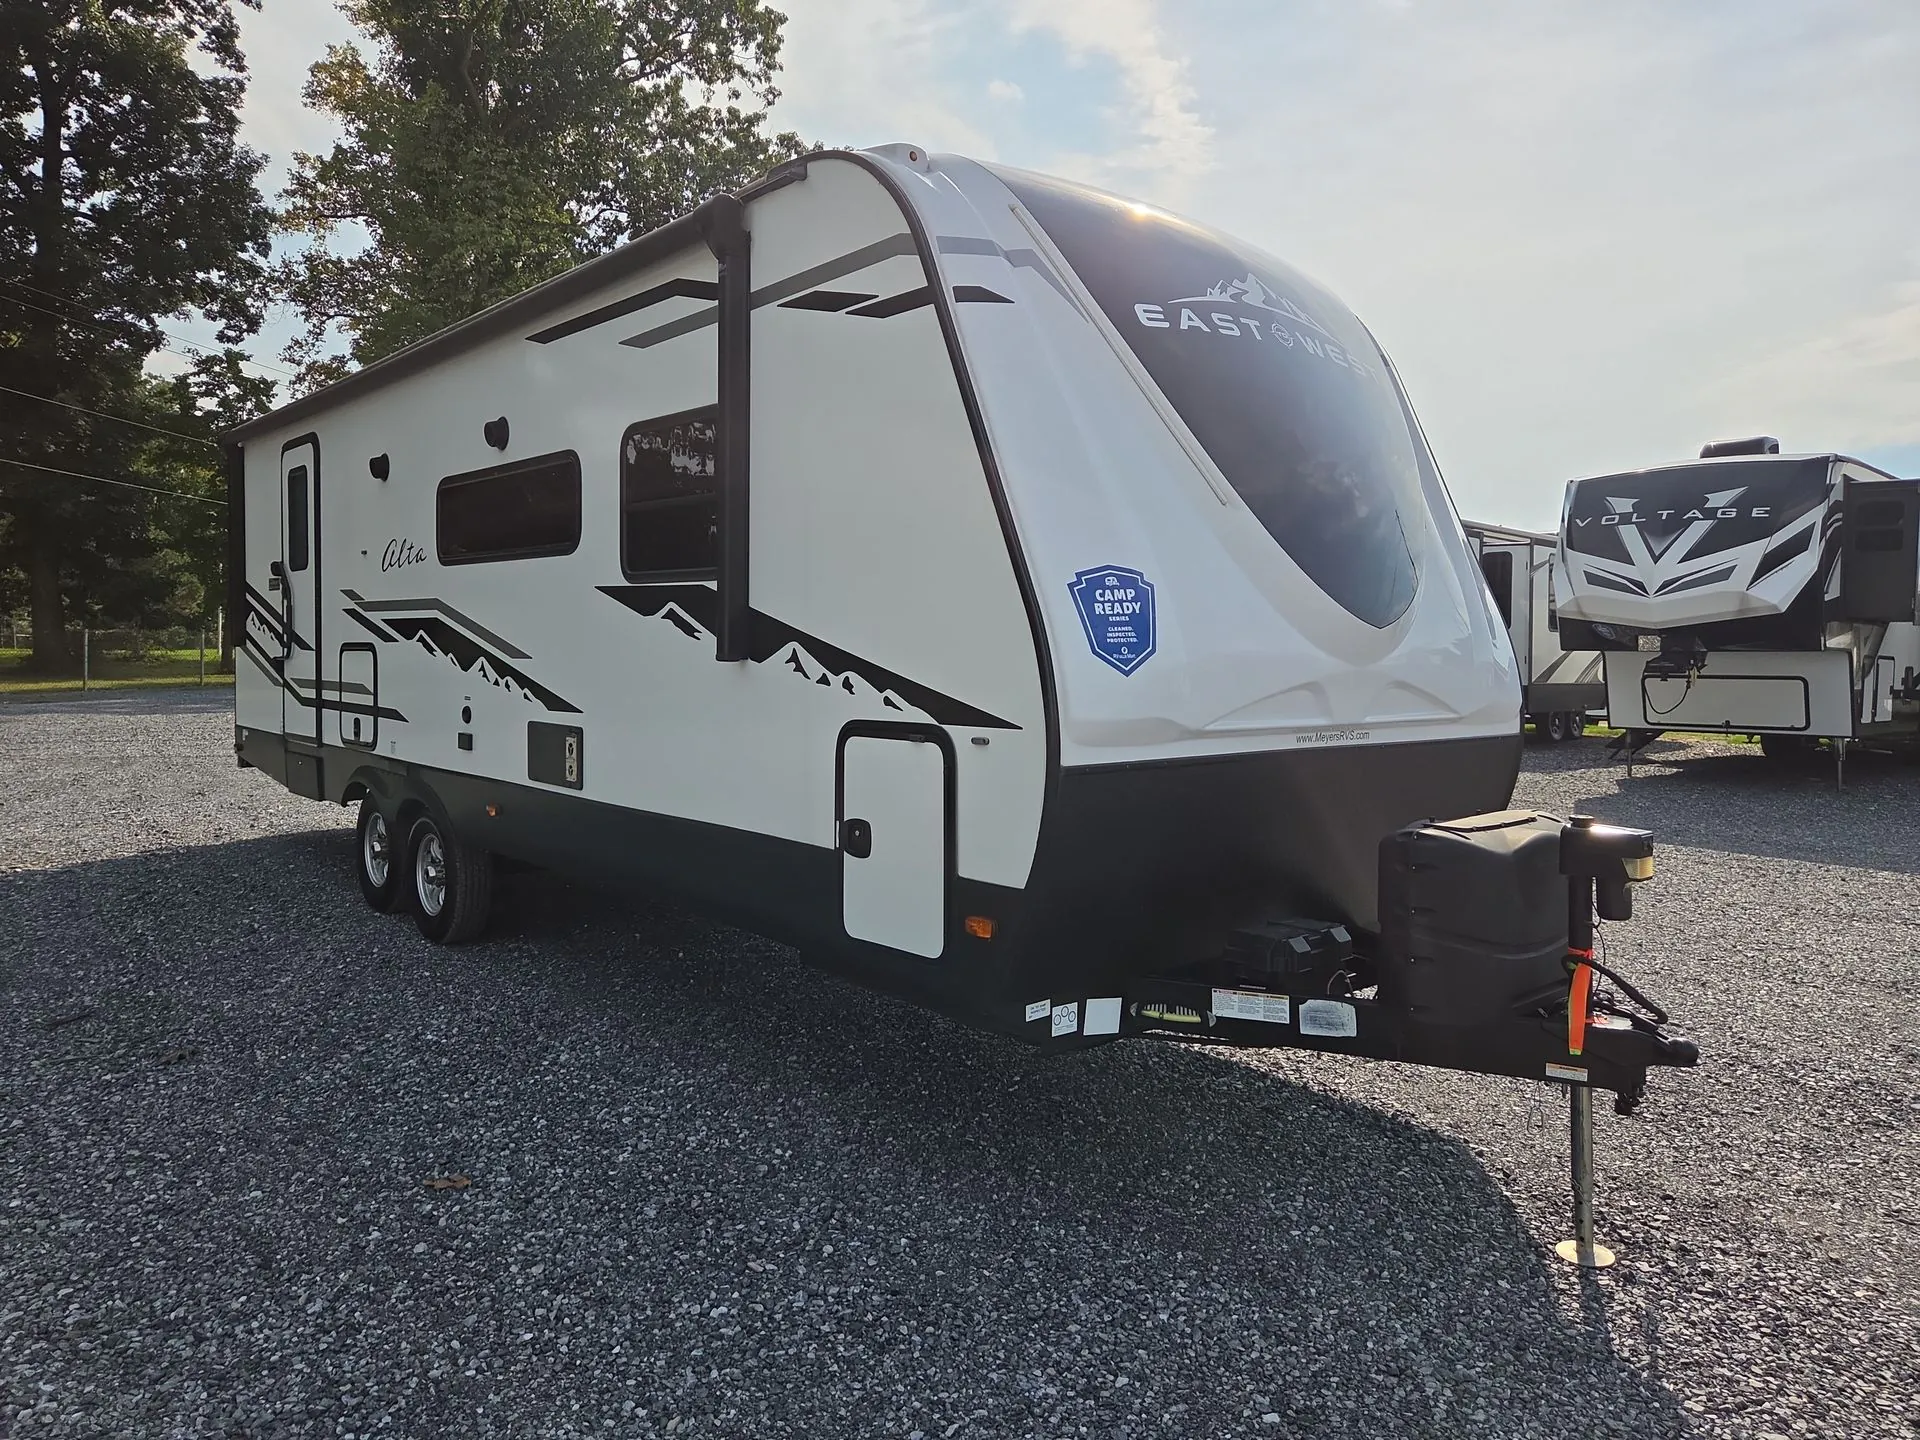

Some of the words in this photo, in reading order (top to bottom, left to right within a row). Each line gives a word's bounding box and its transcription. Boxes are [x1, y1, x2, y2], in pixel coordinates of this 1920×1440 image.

[1133, 303, 1263, 341] EAST
[1296, 332, 1378, 383] WEST
[1575, 507, 1771, 527] VOLTAGE
[1095, 589, 1136, 601] CAMP
[1094, 602, 1141, 615] READY
[1296, 730, 1370, 744] www.MeyersRVS.com
